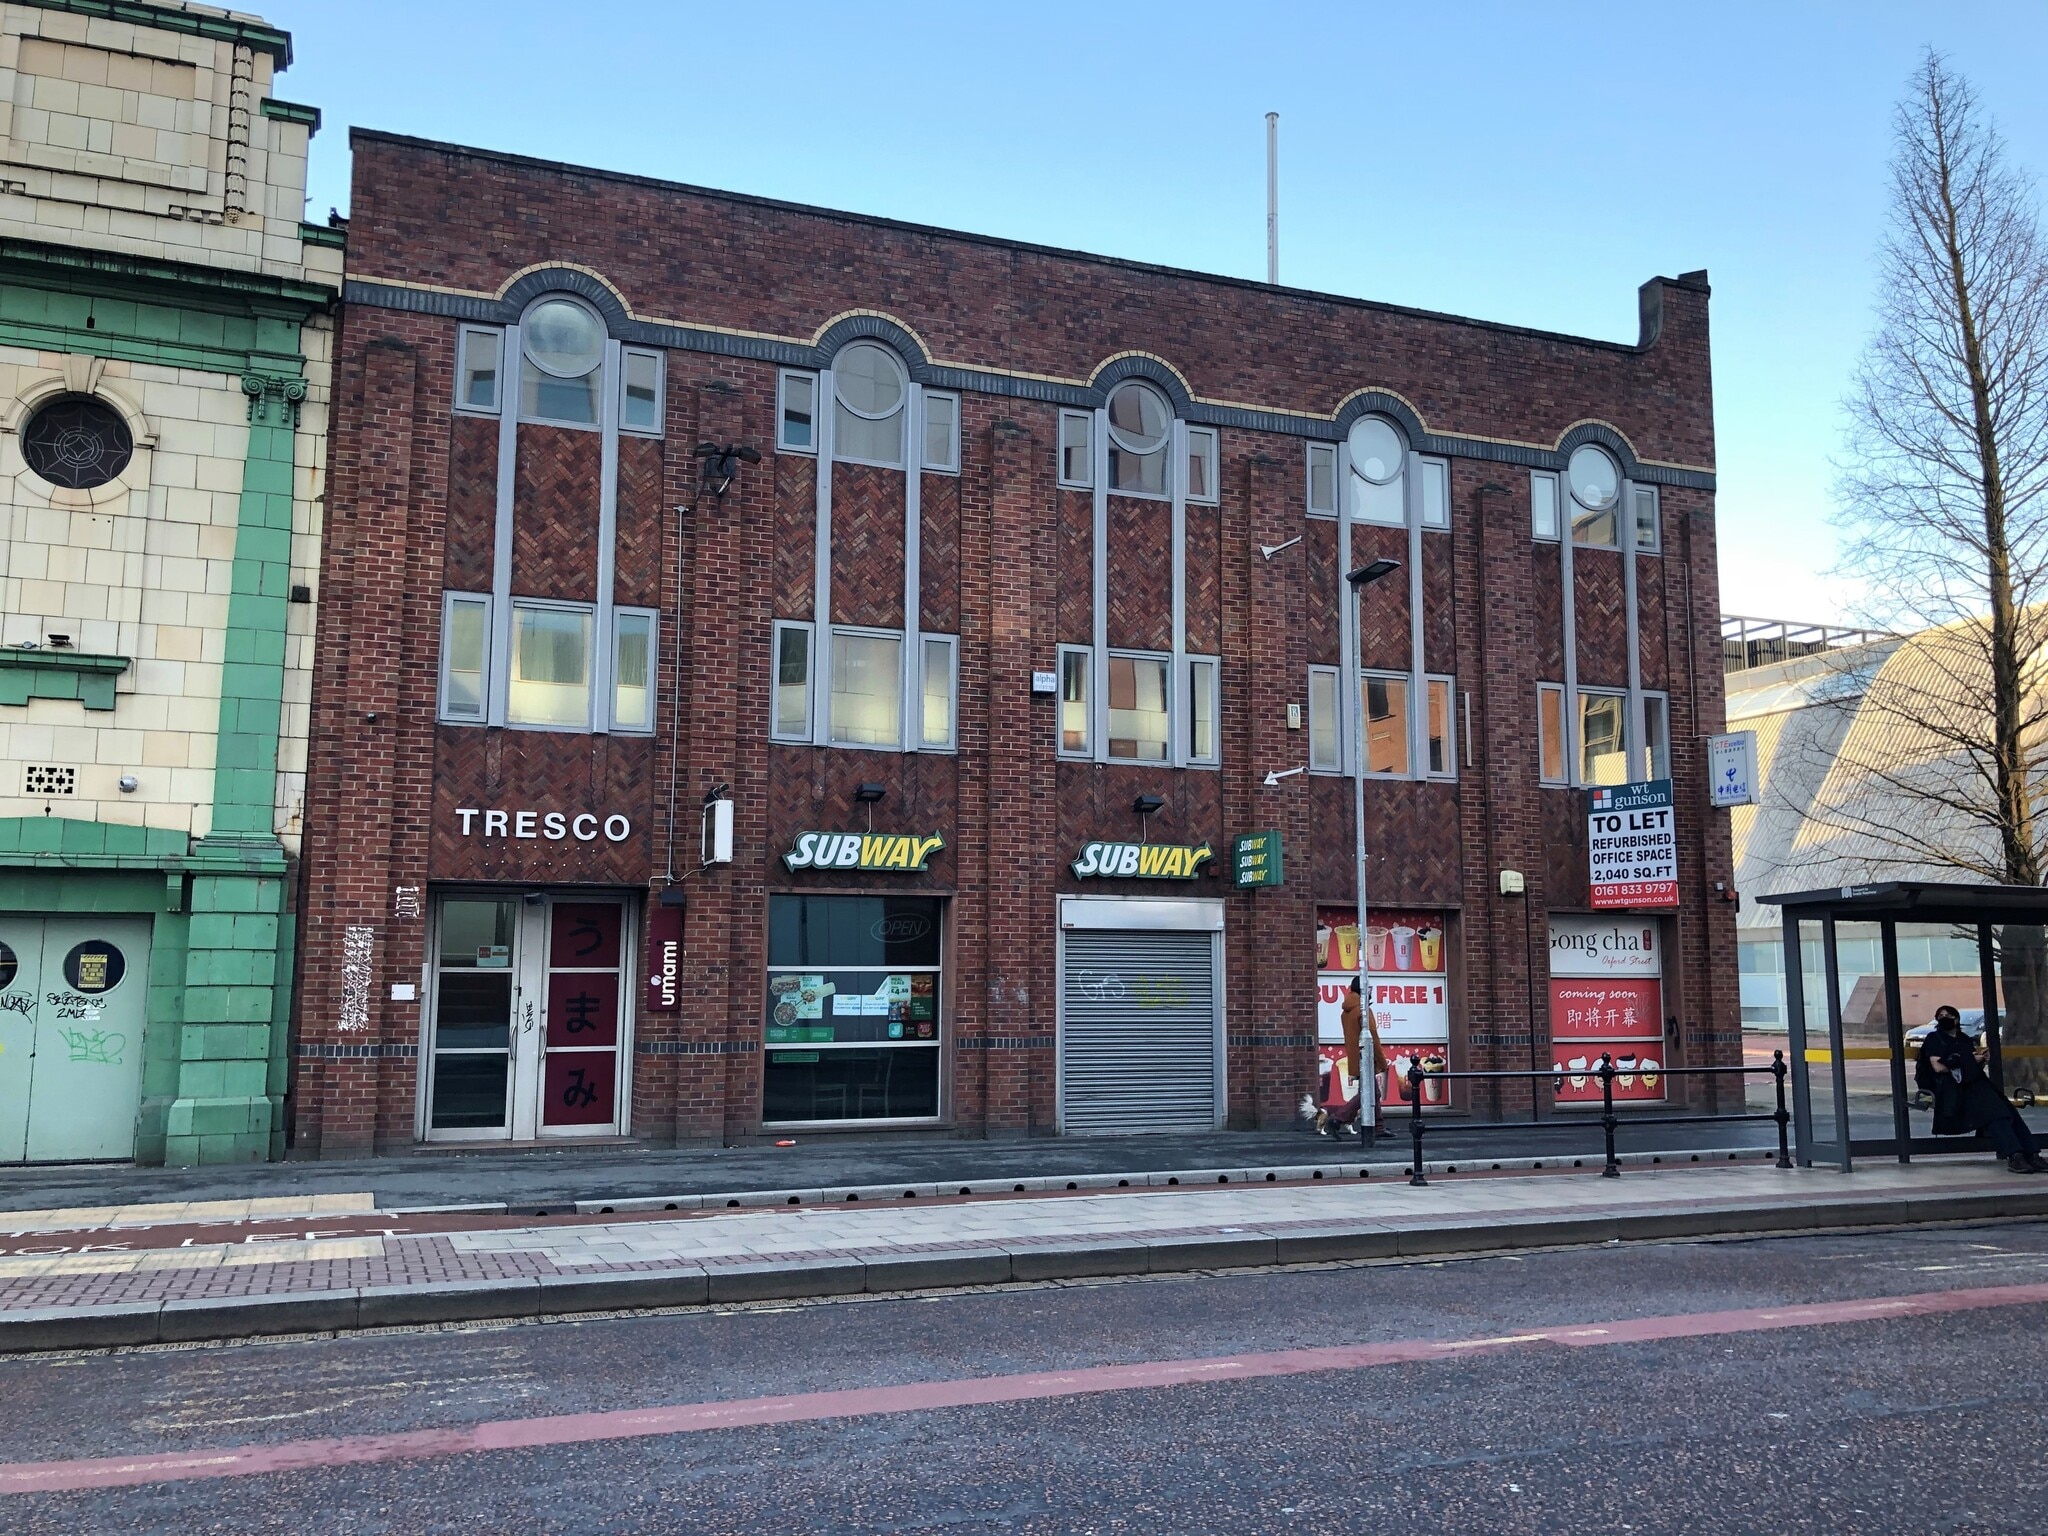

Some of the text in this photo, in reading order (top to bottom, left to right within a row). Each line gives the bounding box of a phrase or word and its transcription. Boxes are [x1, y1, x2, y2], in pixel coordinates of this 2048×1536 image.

[1631, 782, 1650, 795] wt
[1614, 792, 1667, 810] gunson
[455, 808, 631, 842] TRESCO
[1592, 810, 1669, 833] TO LET
[1239, 837, 1267, 853] SUBWAY
[1592, 833, 1672, 850] REFURBISHED
[786, 833, 943, 868] SUBWAY
[1592, 848, 1673, 865] OFFICE SPACE
[1074, 843, 1212, 877] SUBWAY
[1239, 853, 1267, 868] SUBWAY
[1239, 869, 1268, 884] SUBWAY
[1594, 865, 1672, 882] 2,040 SQ.FT
[1594, 882, 1673, 896] 0161 833 9797
[1594, 895, 1674, 906] www.wtgunson.co.uk
[877, 920, 923, 936] OPEN
[1602, 928, 1640, 951] cha
[1601, 955, 1653, 968] Oxford Street
[661, 940, 678, 1006] umami
[1376, 985, 1428, 1005] FREE
[1433, 986, 1443, 1004] 1
[1558, 986, 1638, 1005] coming soon
[1566, 1007, 1639, 1029] 即将开幕
[181, 1228, 411, 1248] LEFT
